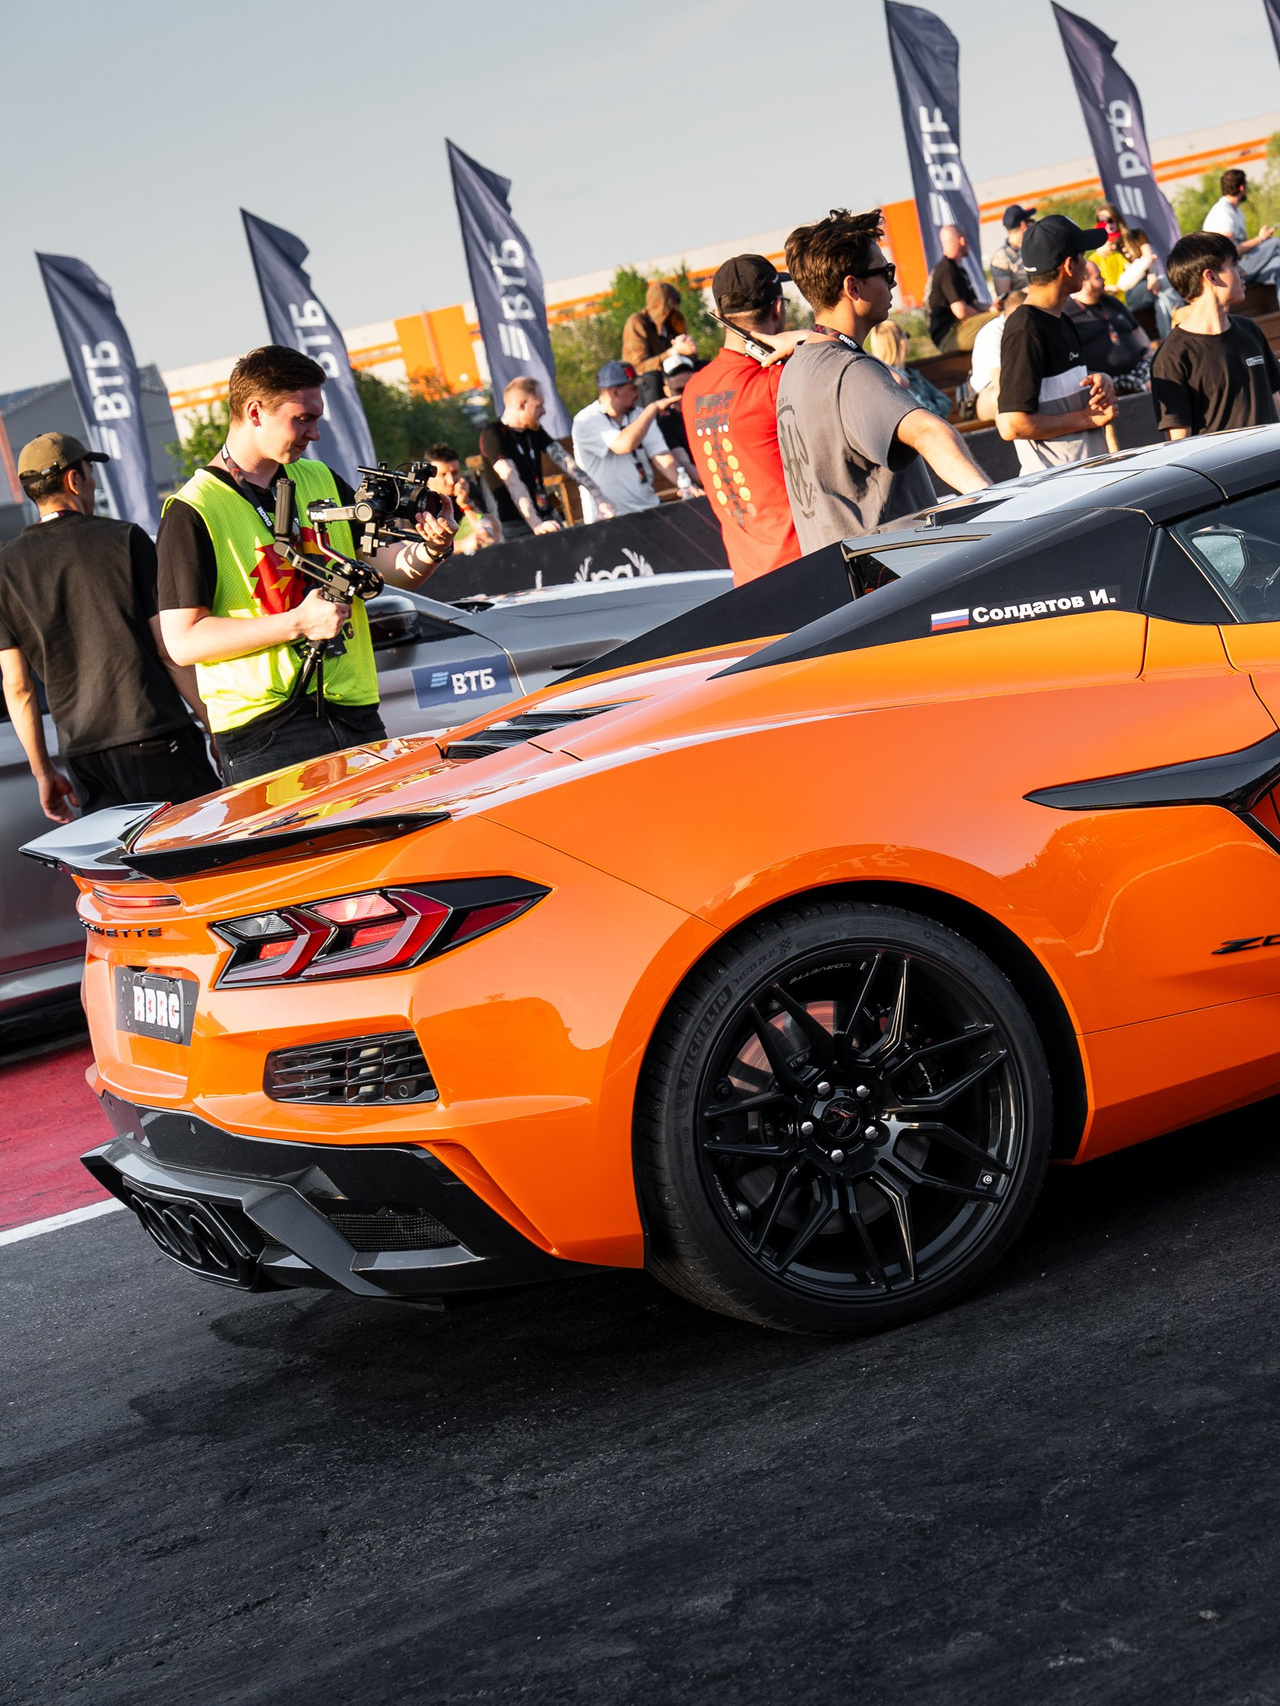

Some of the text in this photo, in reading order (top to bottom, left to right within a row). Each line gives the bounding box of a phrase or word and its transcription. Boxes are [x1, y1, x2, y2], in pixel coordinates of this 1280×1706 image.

[488, 239, 538, 321] ВТБ
[81, 340, 132, 421] ВТБ
[972, 588, 1116, 623] Солдатов И.
[451, 667, 497, 696] ВТБ
[789, 962, 852, 985] CORVETTE
[133, 985, 180, 1030] RDRC
[680, 991, 731, 1083] MICHELIN
[713, 1173, 739, 1220] FORGED
